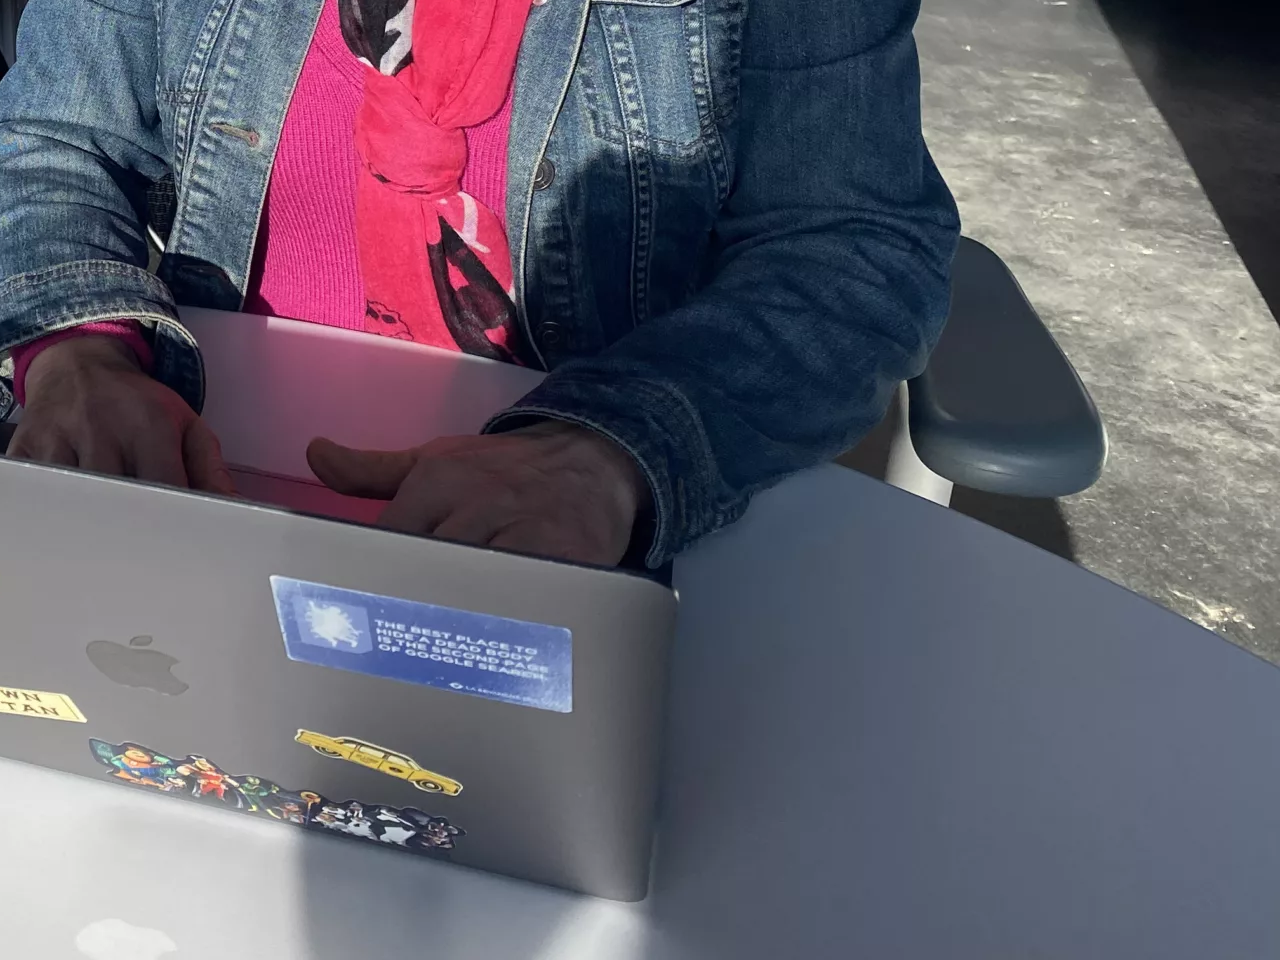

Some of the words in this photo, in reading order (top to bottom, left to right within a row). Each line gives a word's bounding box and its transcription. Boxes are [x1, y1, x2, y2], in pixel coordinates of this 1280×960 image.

[374, 619, 405, 632] THE
[410, 625, 452, 640] BEST
[456, 634, 510, 651] PLACE
[514, 645, 538, 656] TO
[376, 627, 414, 641] HIDE
[419, 636, 430, 644] A
[435, 638, 481, 653] DEAD
[486, 649, 534, 663] BODY
[377, 635, 391, 644] IS
[395, 639, 427, 651] THE
[431, 645, 499, 664] SECOND
[504, 659, 549, 674] PAGE
[378, 643, 401, 652] OF
[405, 648, 473, 668] GOOGLE
